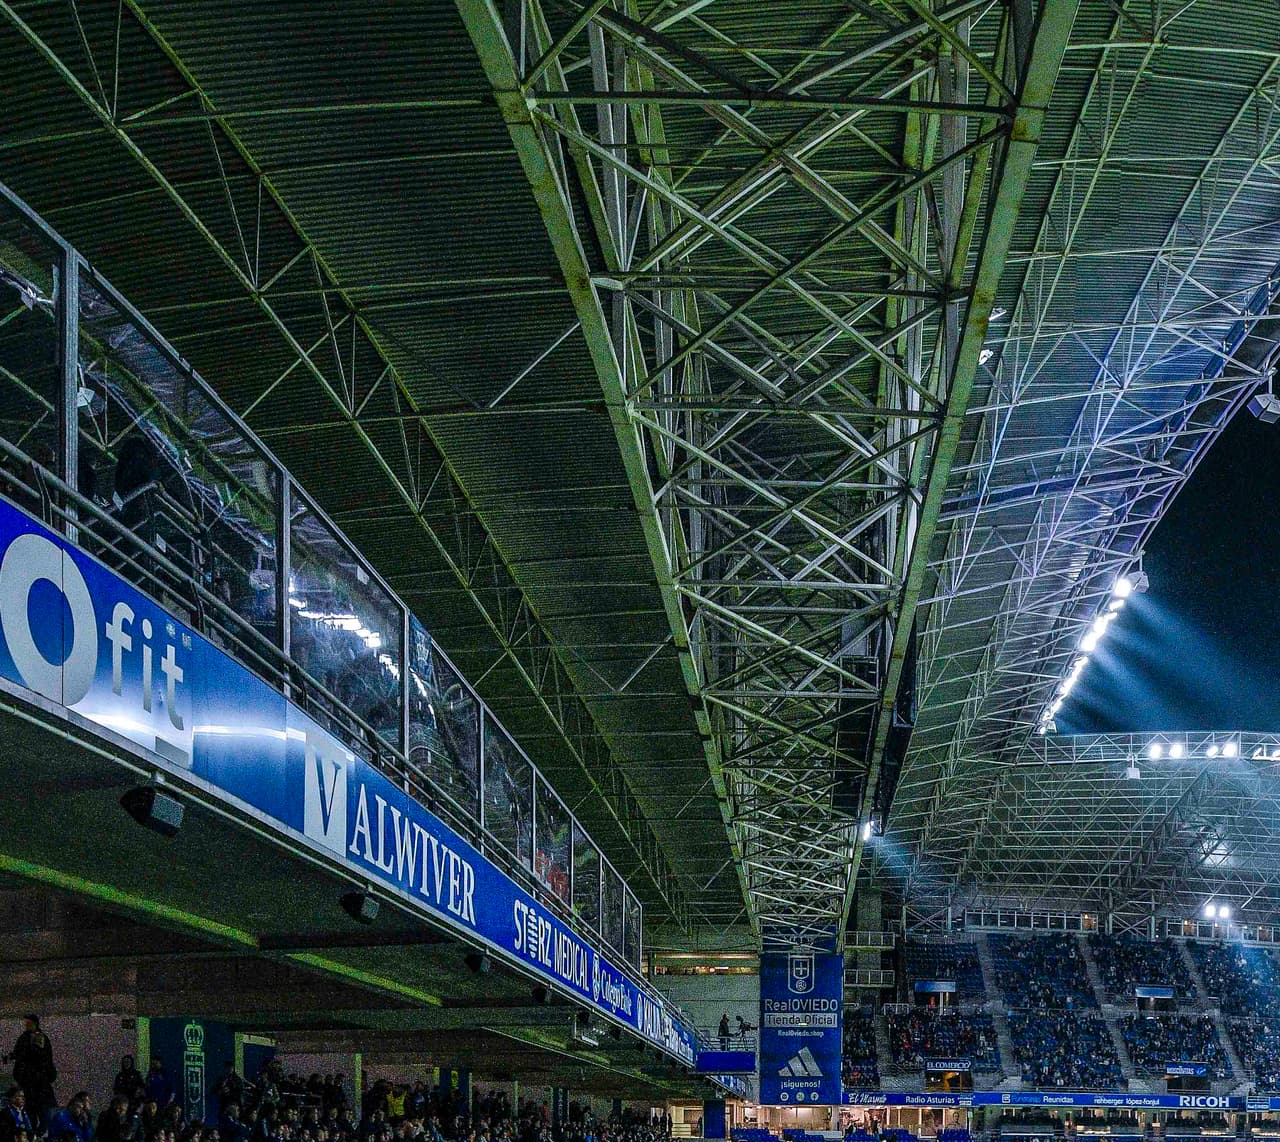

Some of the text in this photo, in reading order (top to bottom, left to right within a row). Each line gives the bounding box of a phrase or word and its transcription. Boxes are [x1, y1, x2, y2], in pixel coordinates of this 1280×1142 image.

[0, 533, 185, 731] O fit
[306, 744, 476, 926] VALWIVER
[554, 927, 590, 992] MEDICAL
[766, 1013, 836, 1025] Tienda Oficial
[905, 1096, 925, 1104] Radio
[926, 1096, 955, 1104] Asturias
[1043, 1096, 1074, 1104] Reunidas
[1179, 1095, 1230, 1108] RICOH
